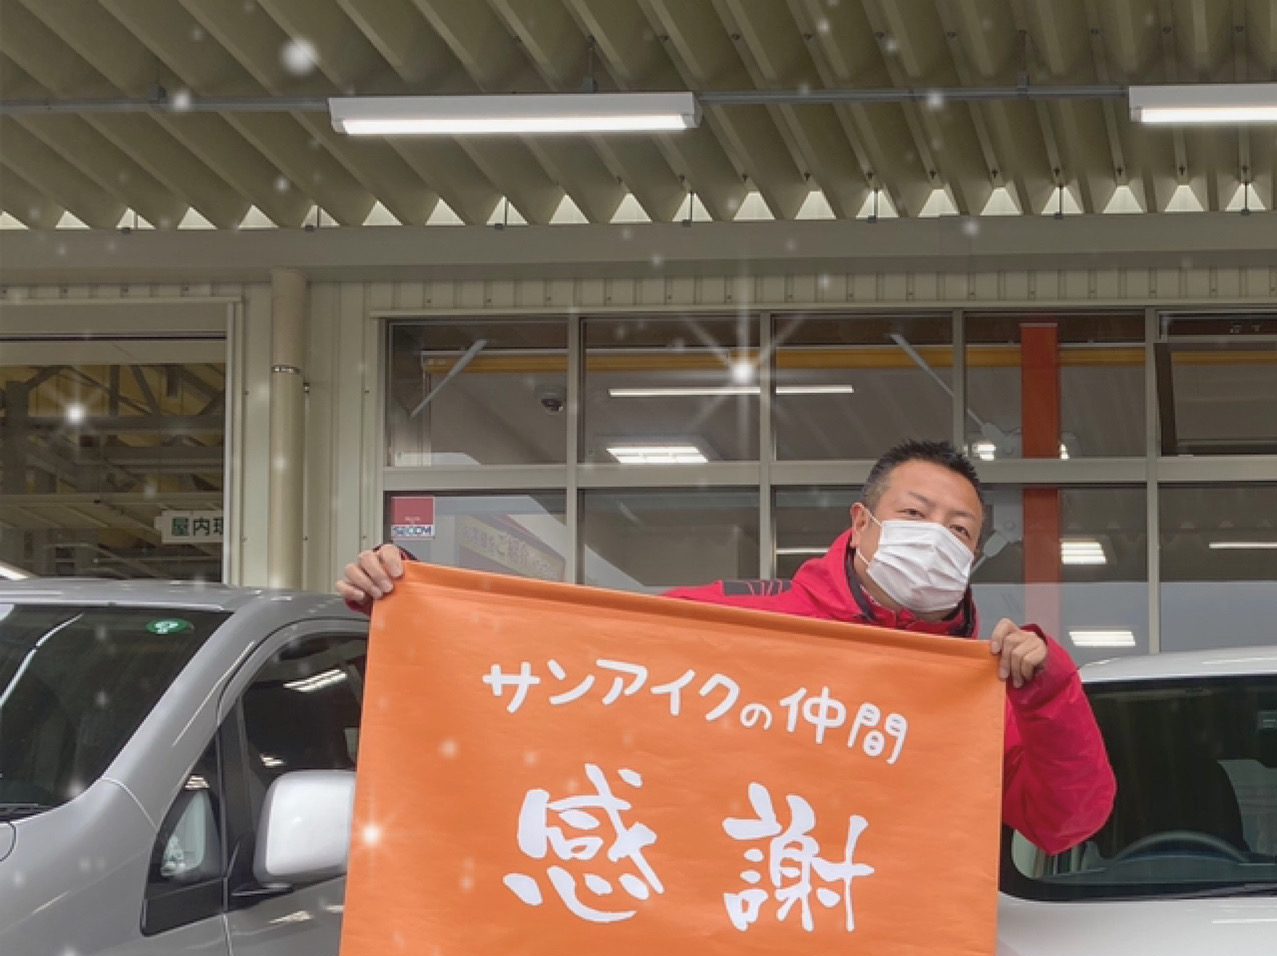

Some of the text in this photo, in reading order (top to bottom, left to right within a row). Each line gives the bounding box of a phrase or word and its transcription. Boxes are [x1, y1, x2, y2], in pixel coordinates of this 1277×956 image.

[482, 657, 908, 764] サンアイクの仲間
